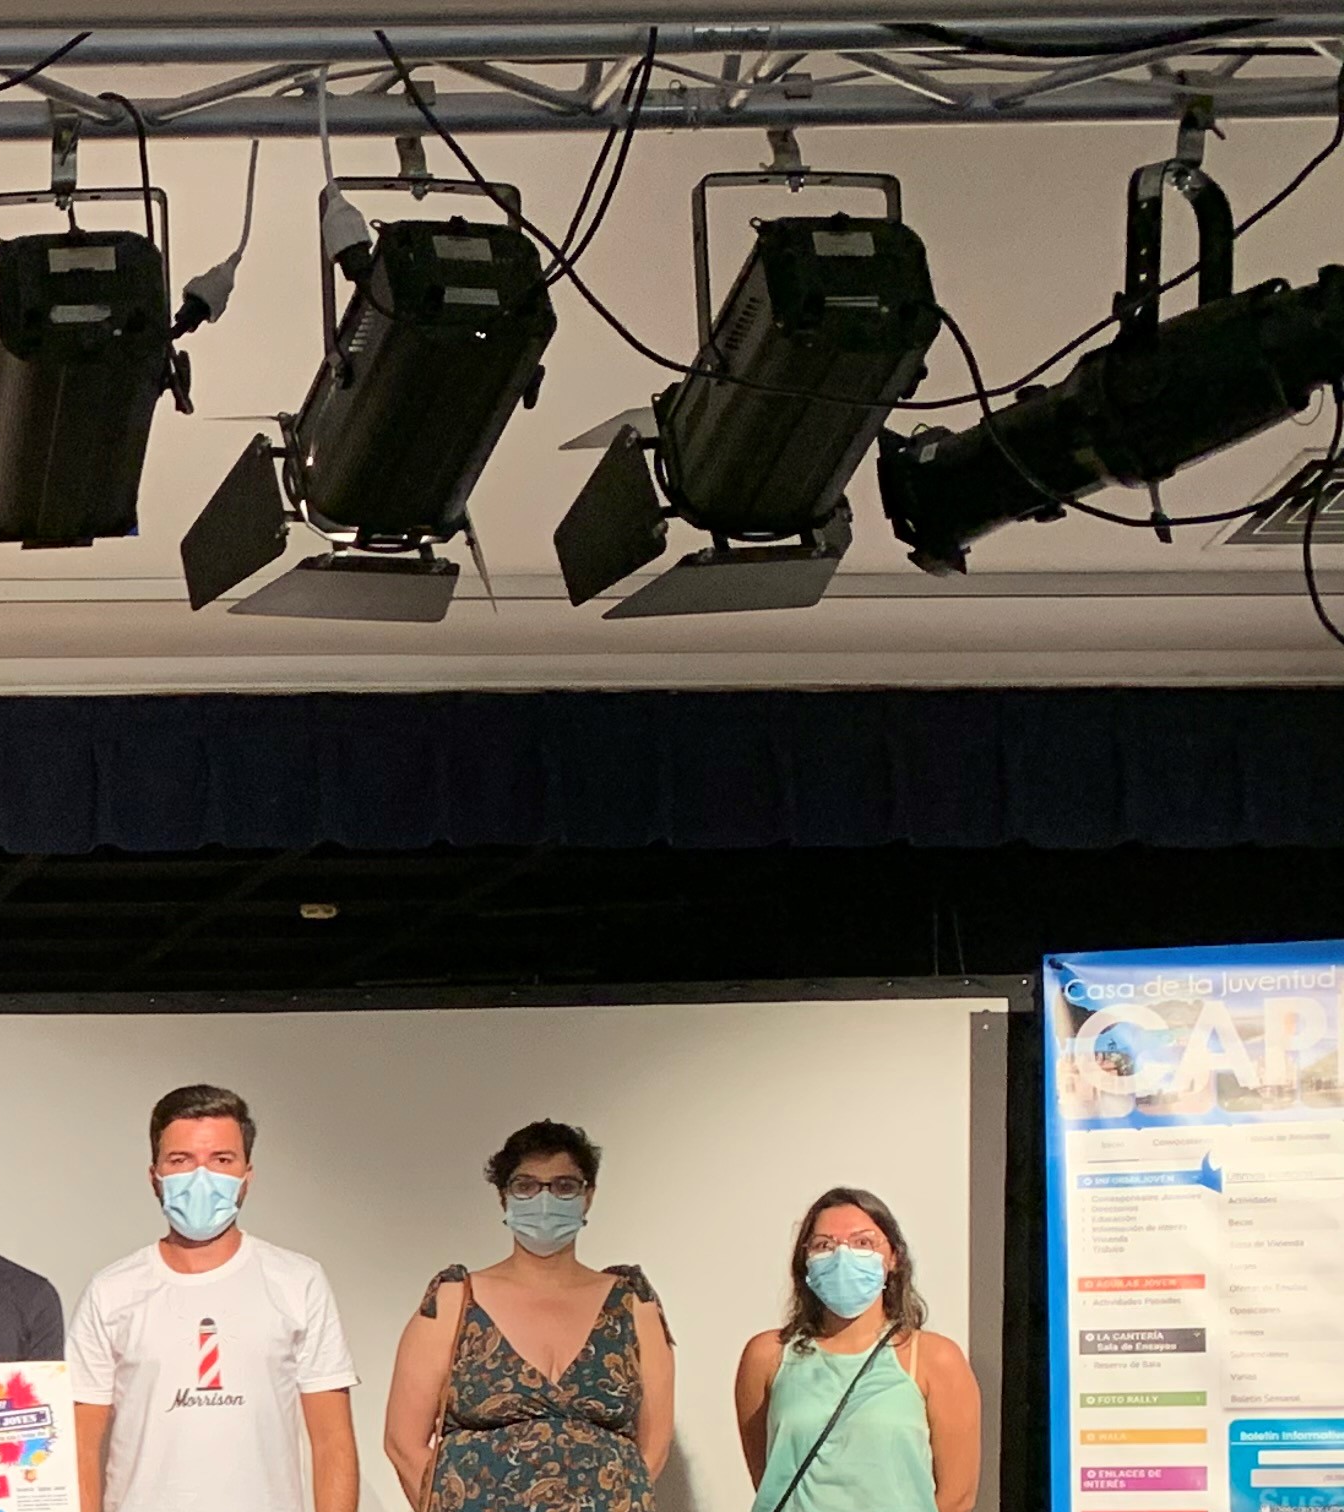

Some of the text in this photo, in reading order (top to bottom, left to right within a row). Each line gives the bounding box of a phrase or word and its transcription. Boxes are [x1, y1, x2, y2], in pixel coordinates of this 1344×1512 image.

[1064, 965, 1336, 1001] Casa de la Juventud
[1112, 1332, 1164, 1340] CANTERÍA
[1121, 1343, 1133, 1351] de
[164, 1387, 247, 1413] Morrison
